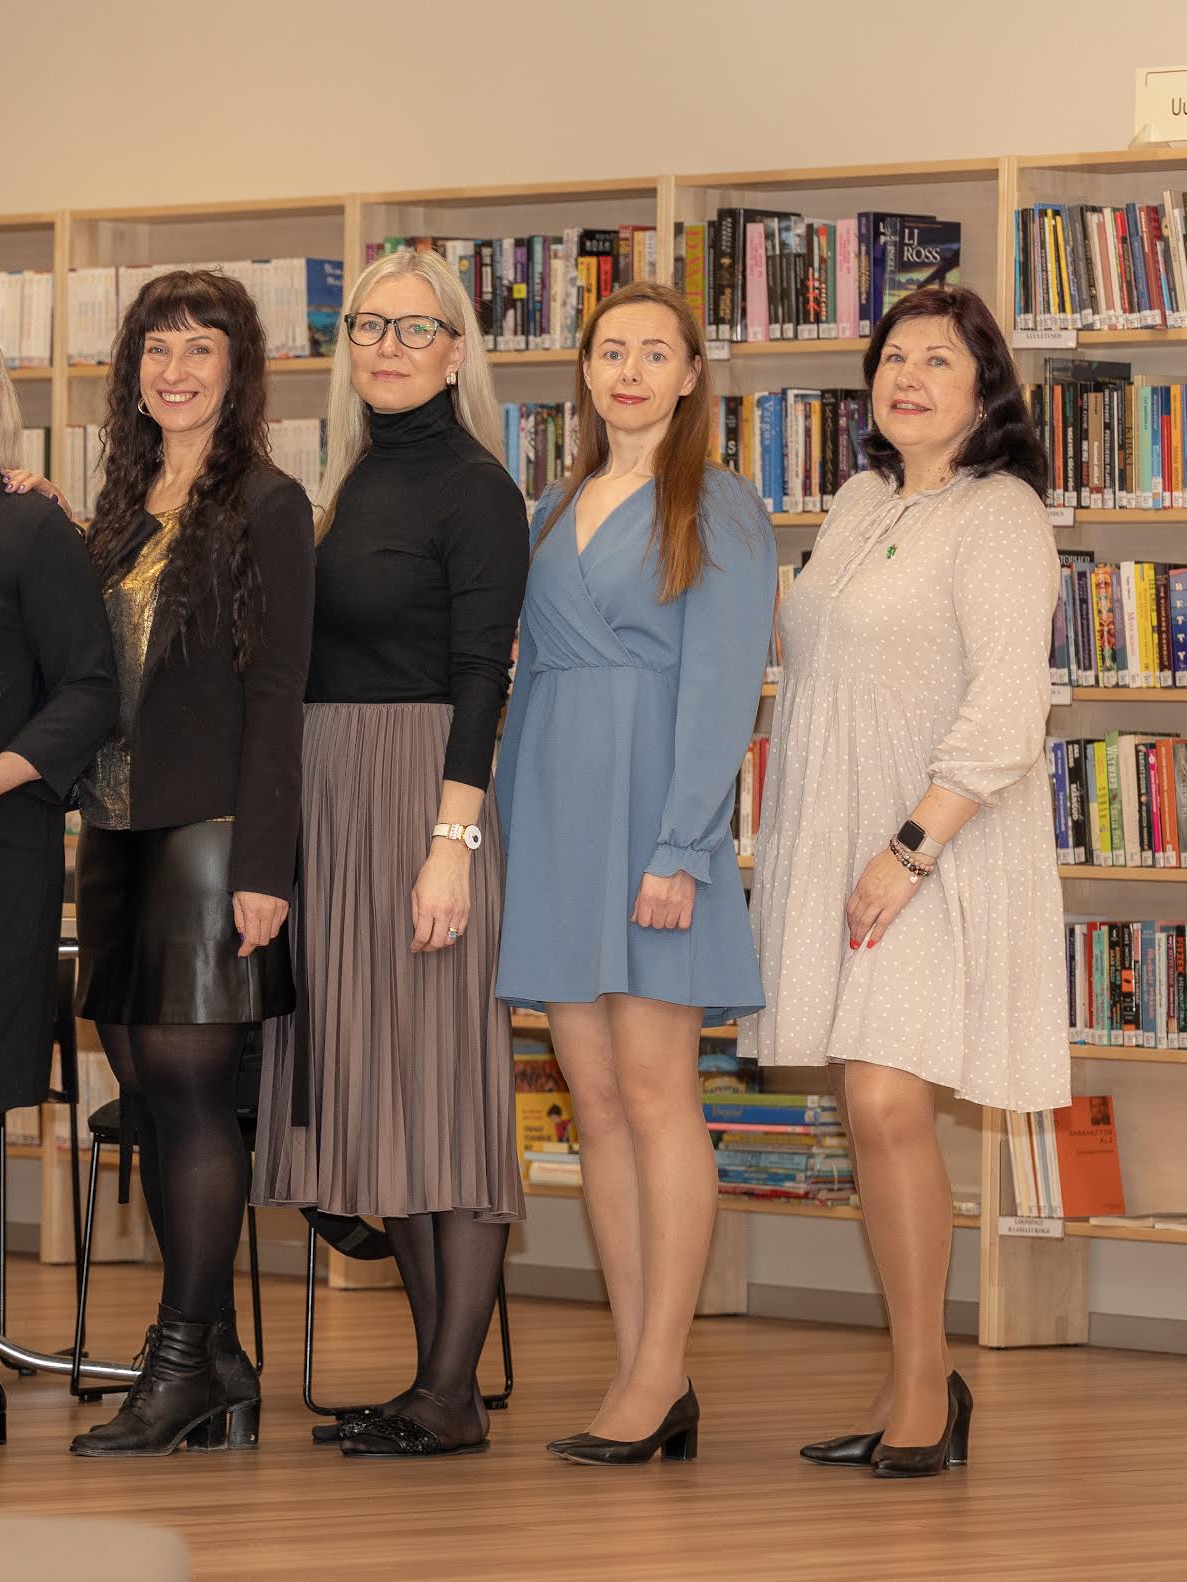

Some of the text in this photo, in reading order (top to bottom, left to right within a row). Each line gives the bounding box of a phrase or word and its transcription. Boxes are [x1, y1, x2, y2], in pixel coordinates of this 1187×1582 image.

[904, 228, 918, 246] LJ
[903, 245, 940, 262] ROSS
[1107, 744, 1118, 789] WEYWARD
